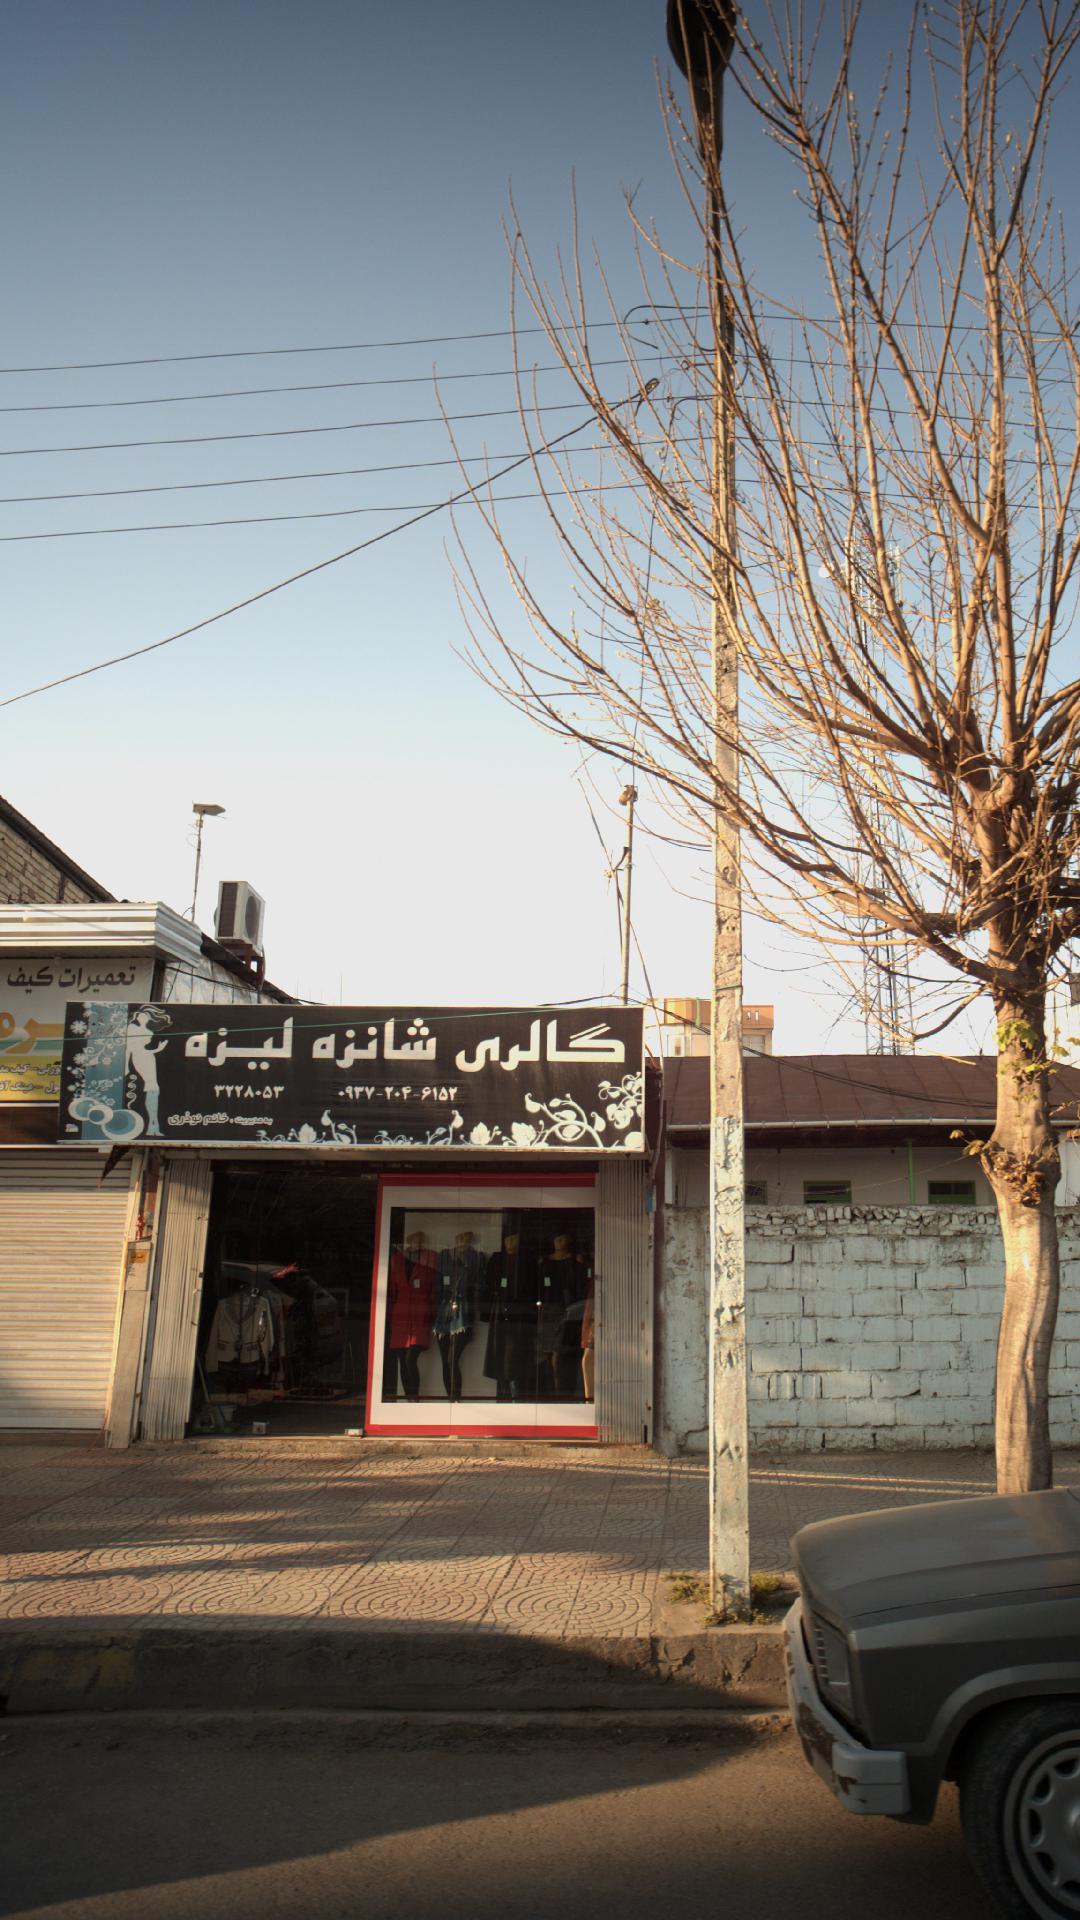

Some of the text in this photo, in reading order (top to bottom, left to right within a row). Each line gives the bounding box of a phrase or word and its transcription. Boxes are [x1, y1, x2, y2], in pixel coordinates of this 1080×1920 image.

[7, 966, 137, 994] تعمیرات کیف
[184, 1016, 626, 1073] گالری شانزه لیزه
[213, 1084, 285, 1099] ۳۲۲۸۰۵۳
[203, 1112, 230, 1126] خانم
